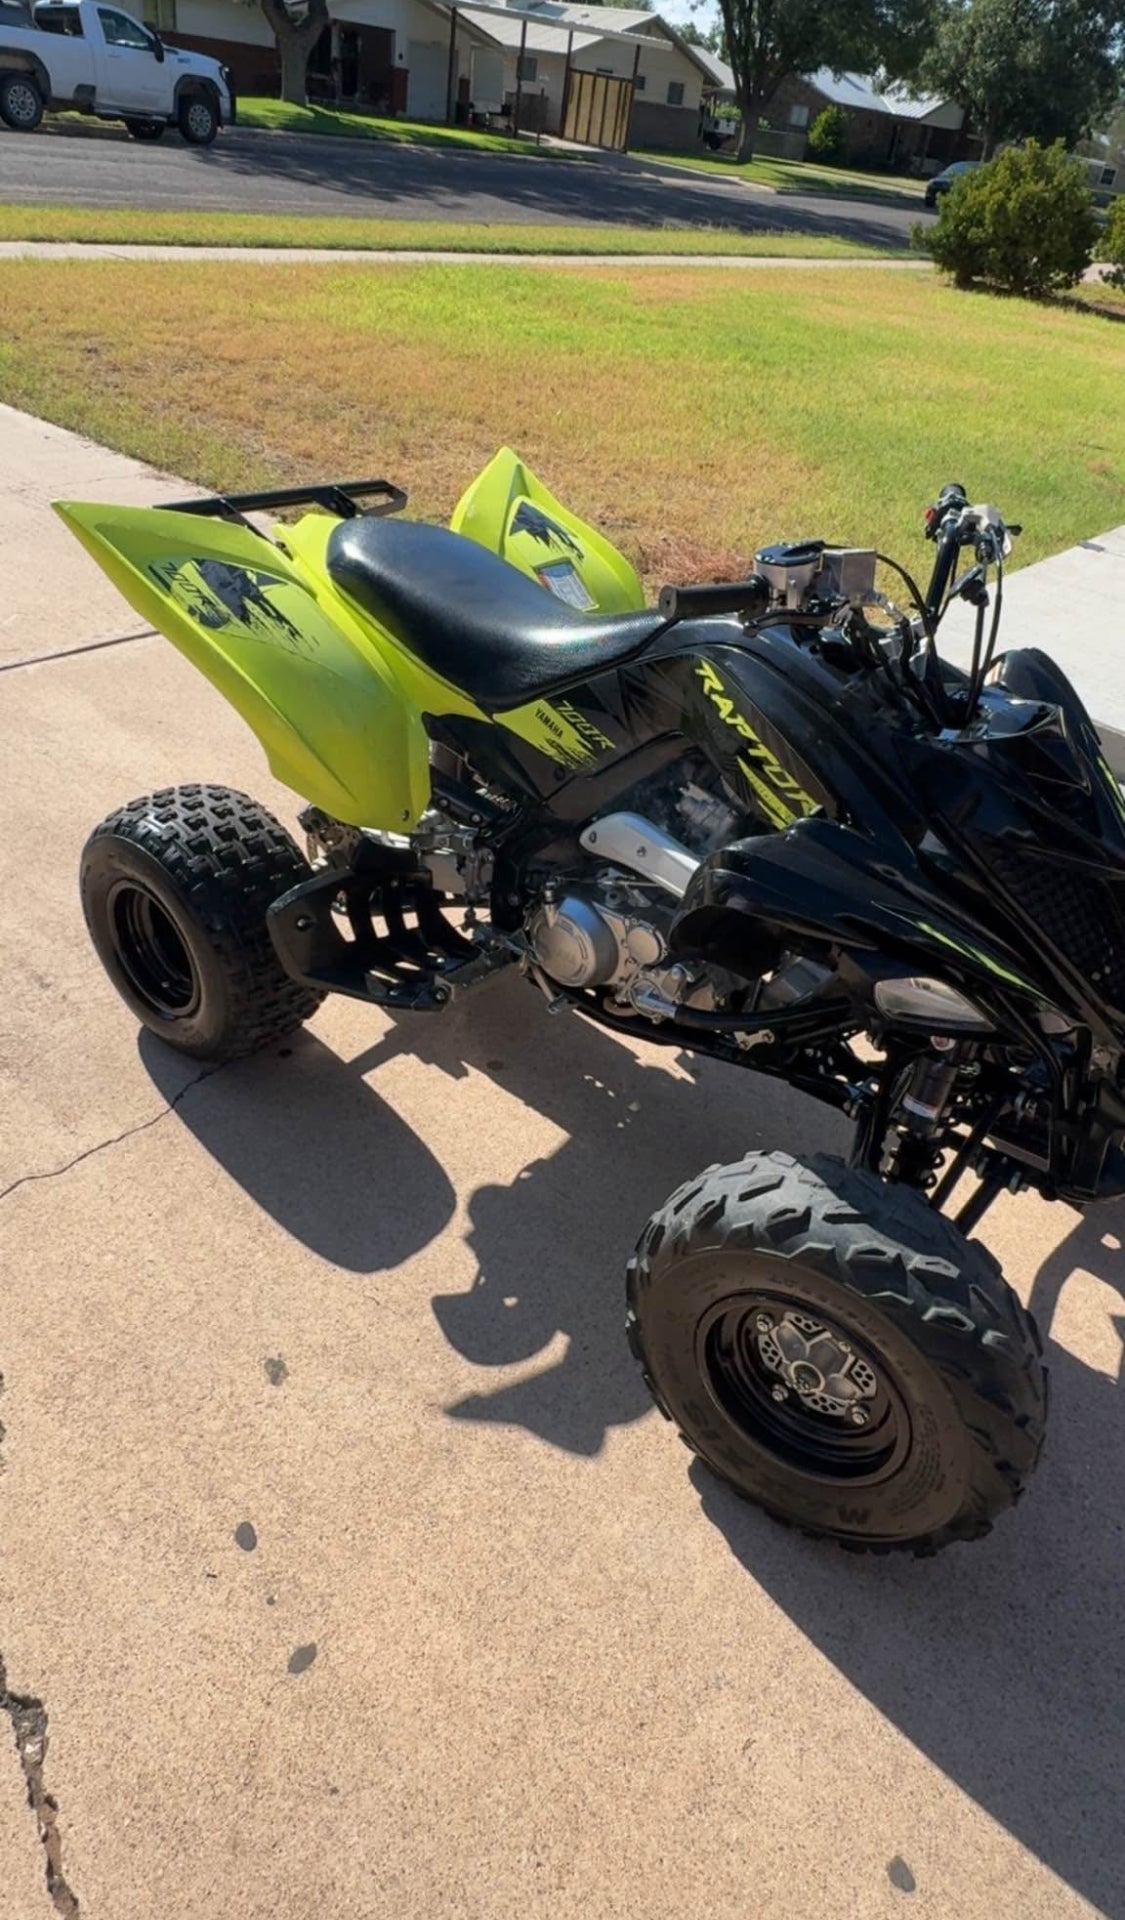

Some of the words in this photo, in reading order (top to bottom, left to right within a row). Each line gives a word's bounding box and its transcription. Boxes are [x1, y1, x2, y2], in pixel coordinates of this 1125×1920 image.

[159, 561, 217, 608] 700R
[534, 707, 564, 739] YAMAHA
[557, 699, 617, 749] 700R
[695, 658, 819, 817] RAPTOR
